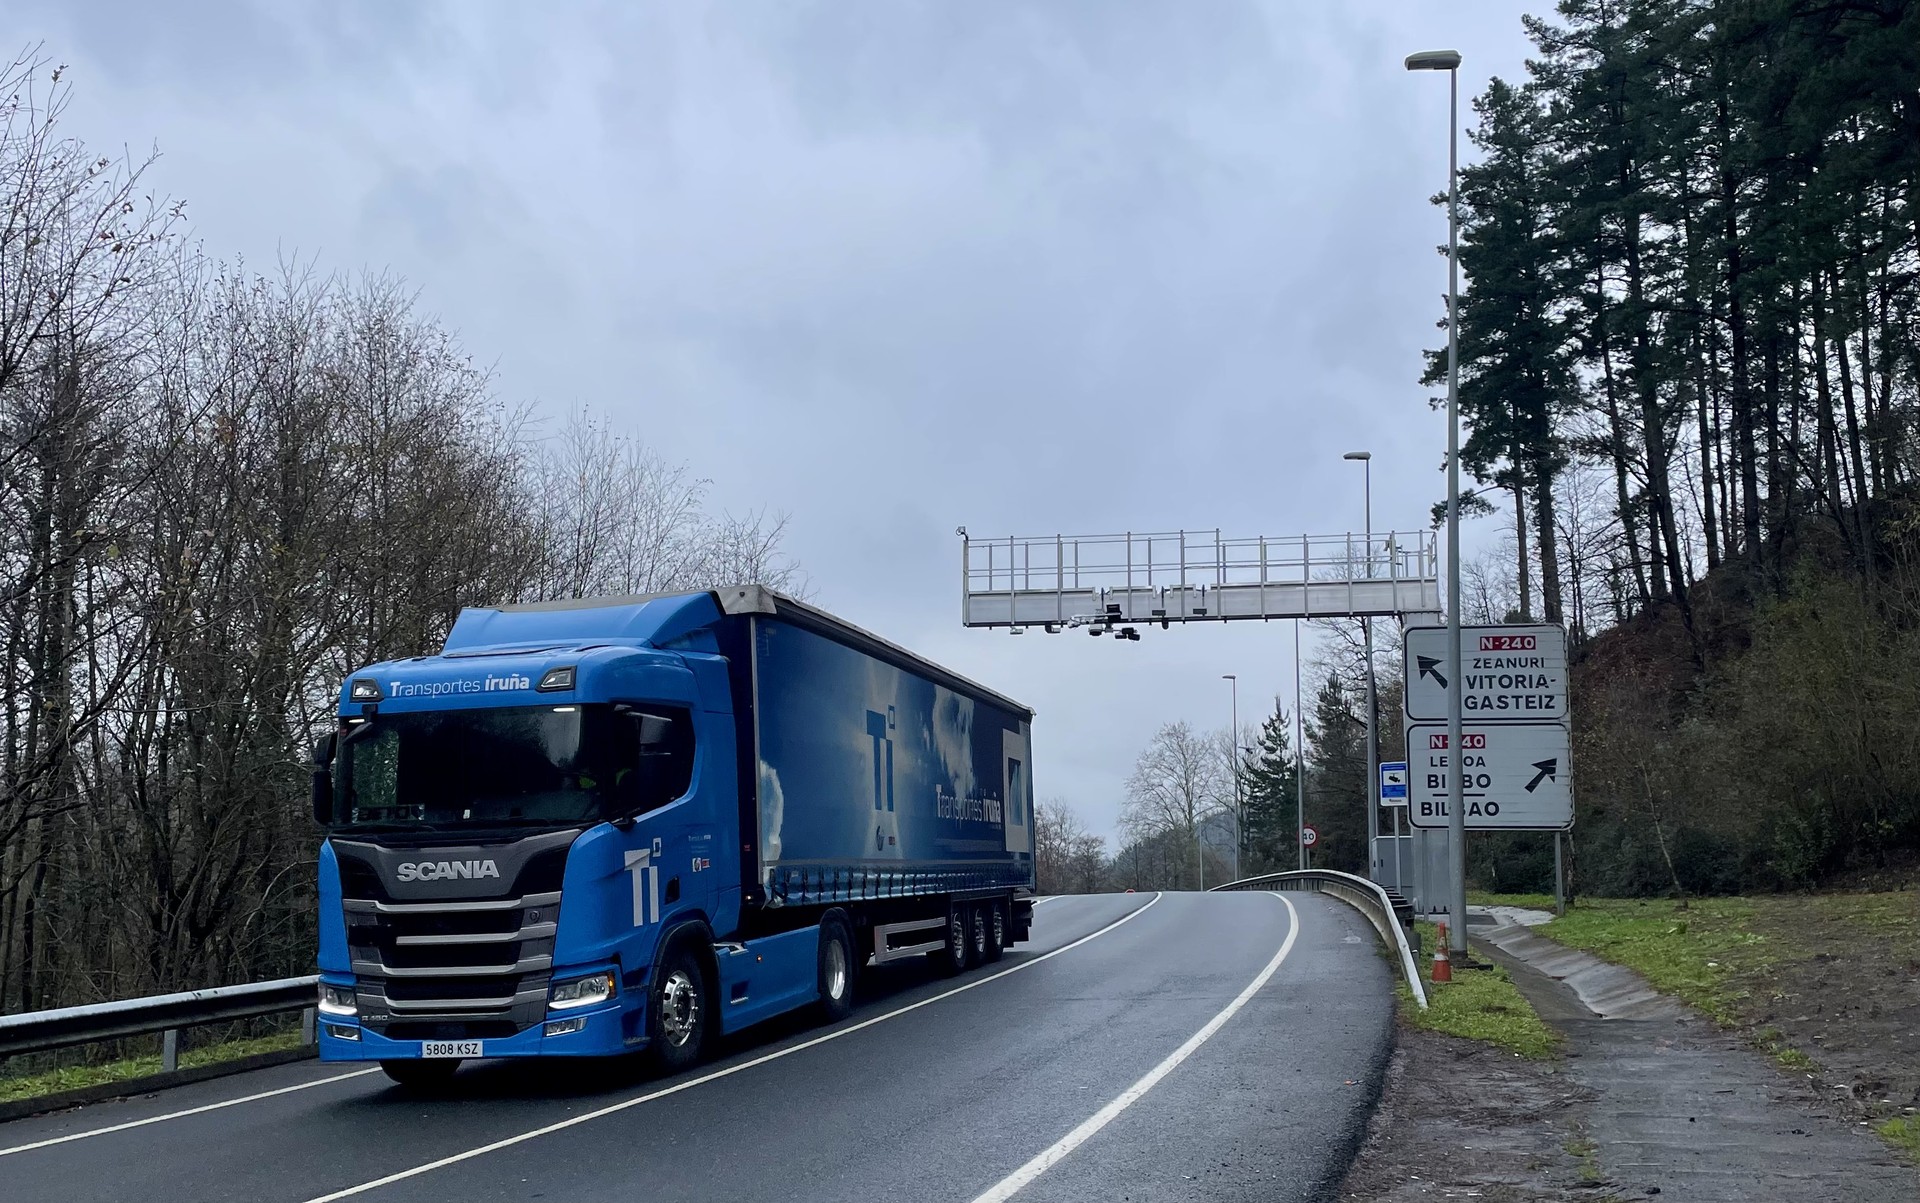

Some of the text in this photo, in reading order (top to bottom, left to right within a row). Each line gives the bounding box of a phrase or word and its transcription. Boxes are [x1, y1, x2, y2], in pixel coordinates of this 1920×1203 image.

[1481, 636, 1535, 650] N-240
[1473, 657, 1545, 669] ZEANURI
[390, 673, 530, 699] Transportes iruña
[1465, 674, 1556, 690] VITORIA-
[1464, 694, 1556, 710] GASTEIZ
[1430, 735, 1485, 748] N-40
[1430, 756, 1486, 767] LEOA
[1427, 774, 1491, 789] BIBO
[1421, 801, 1500, 817] BILAO
[396, 860, 500, 882] SCANIA
[426, 1043, 478, 1055] 5808 KSZ
